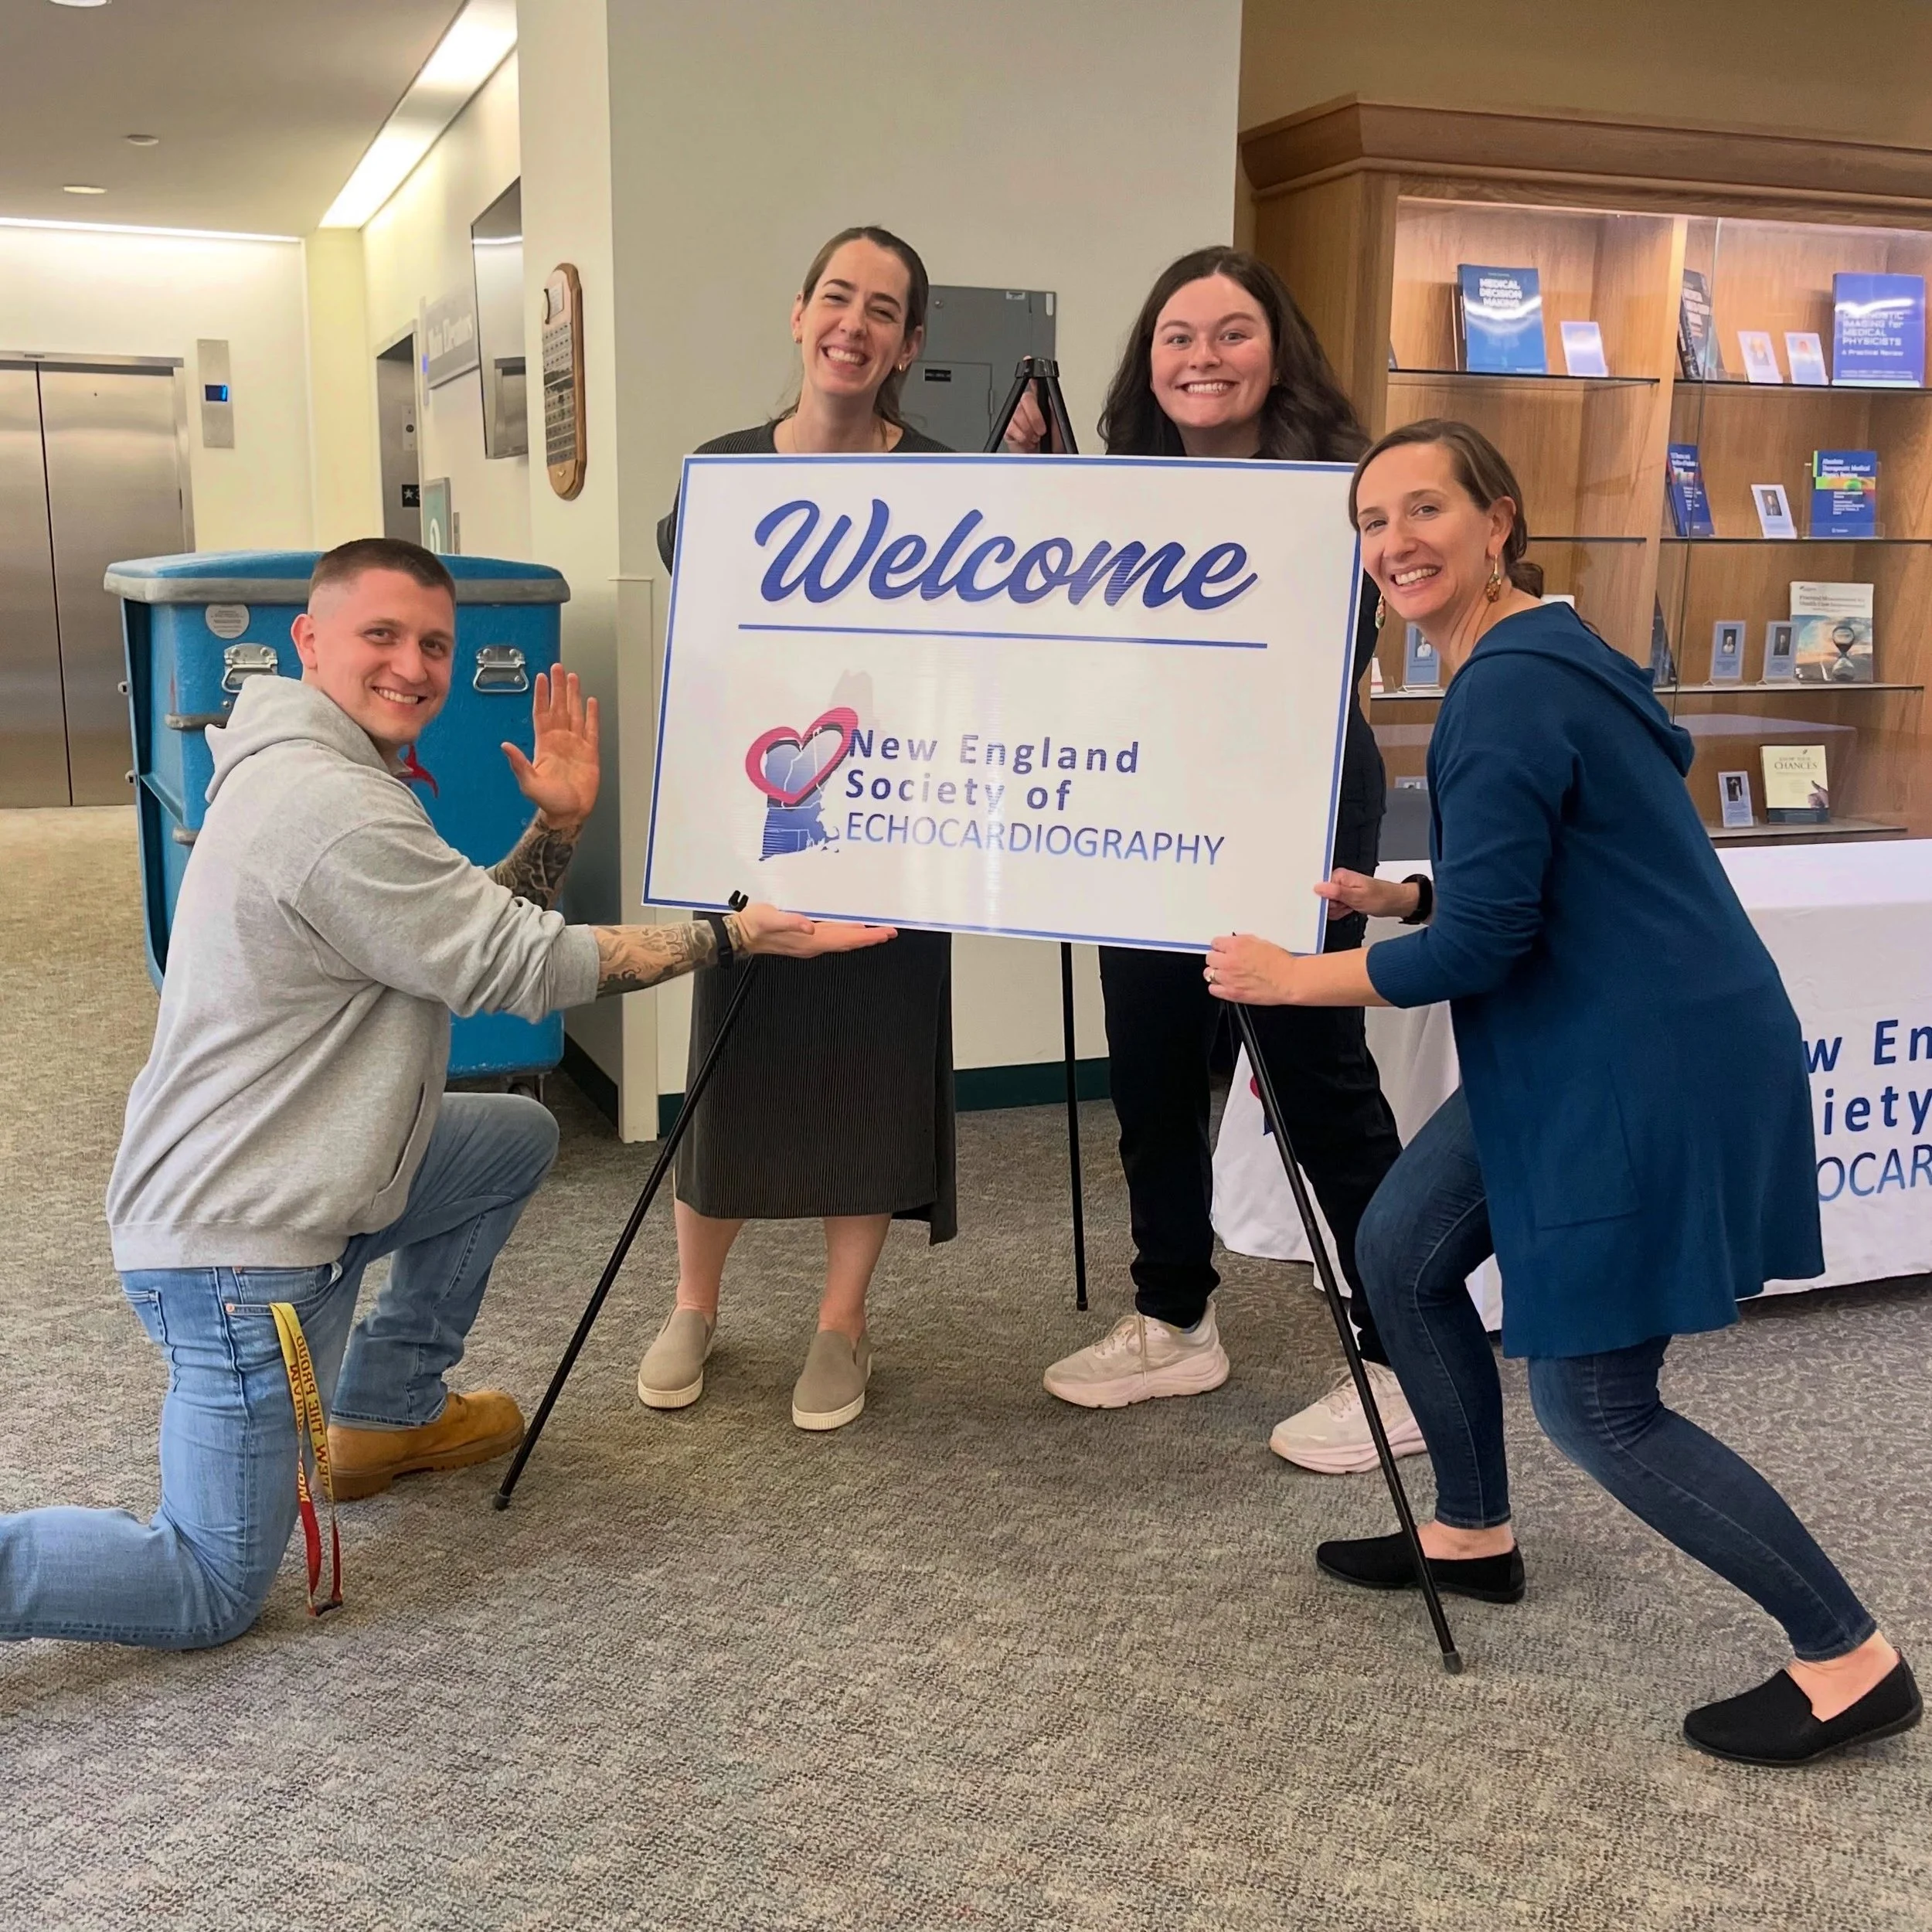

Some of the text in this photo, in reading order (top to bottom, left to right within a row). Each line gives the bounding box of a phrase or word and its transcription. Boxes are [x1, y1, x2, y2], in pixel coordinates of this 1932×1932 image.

[1479, 278, 1520, 290] MEDICAL
[1479, 287, 1522, 299] DECISION
[1843, 328, 1886, 337] MEDICAL
[1842, 337, 1902, 346] PHYSICISTS
[754, 498, 1258, 611] Welcome
[849, 729, 1139, 774] New England
[1774, 761, 1818, 770] CHANCES
[845, 770, 1072, 815] Society of
[846, 811, 1225, 865] ECHOCARDIOGRAPHY
